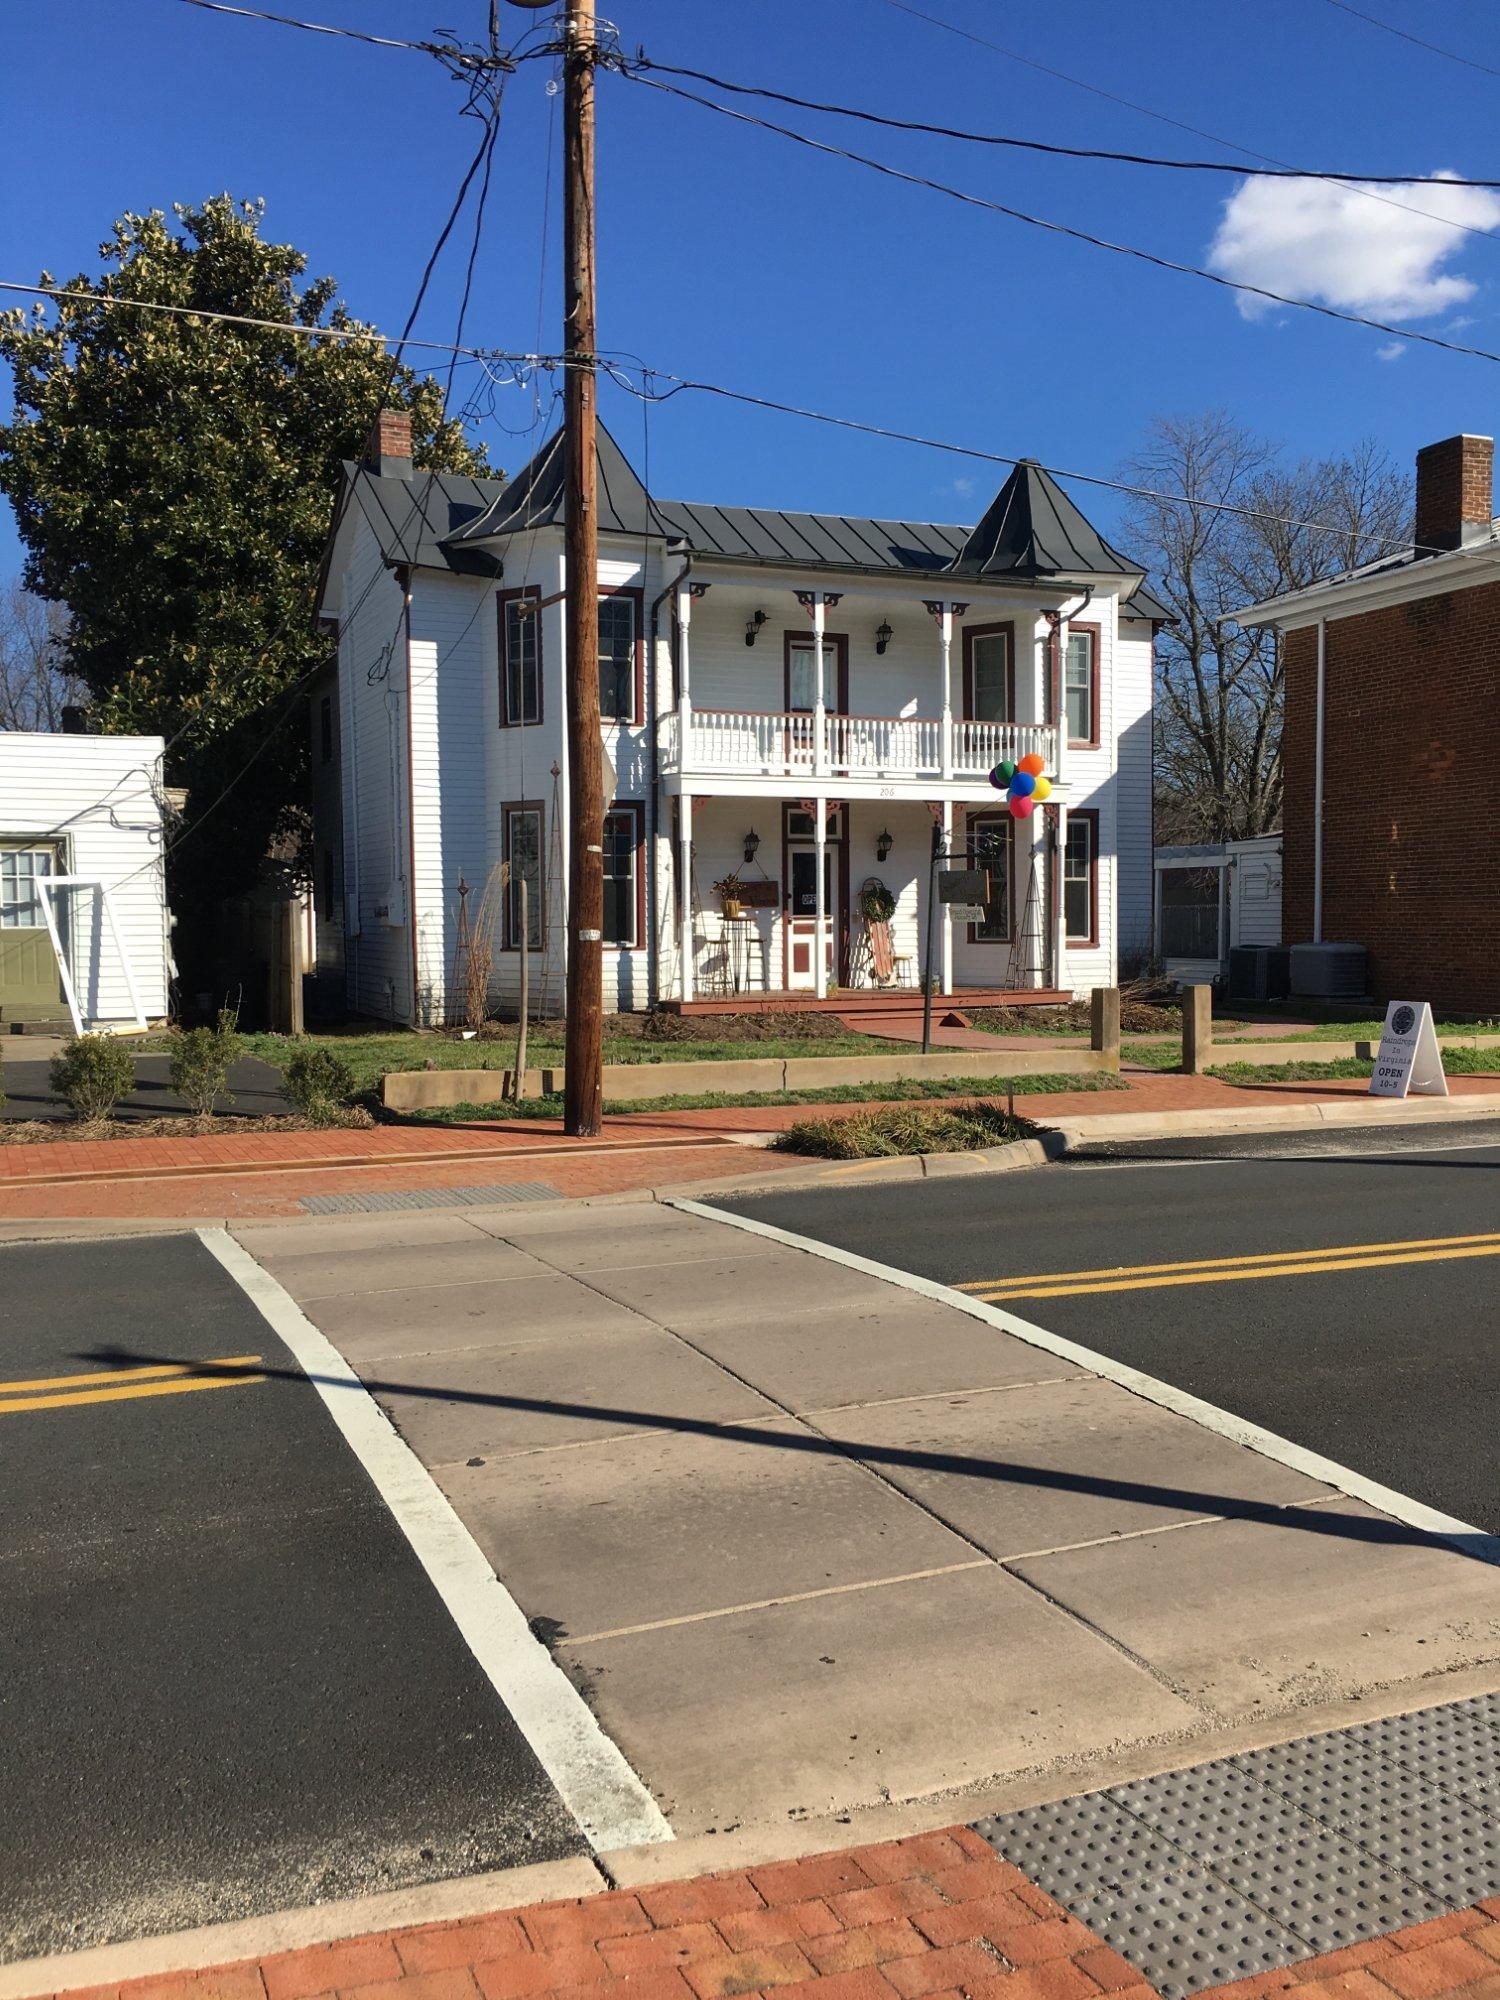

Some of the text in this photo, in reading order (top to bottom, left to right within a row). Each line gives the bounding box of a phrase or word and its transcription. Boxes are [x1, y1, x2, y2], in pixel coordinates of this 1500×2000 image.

[880, 787, 895, 796] 206
[1378, 1055, 1411, 1064] Virginia
[1379, 1068, 1403, 1078] OPEN
[1380, 1080, 1398, 1088] 10-5
